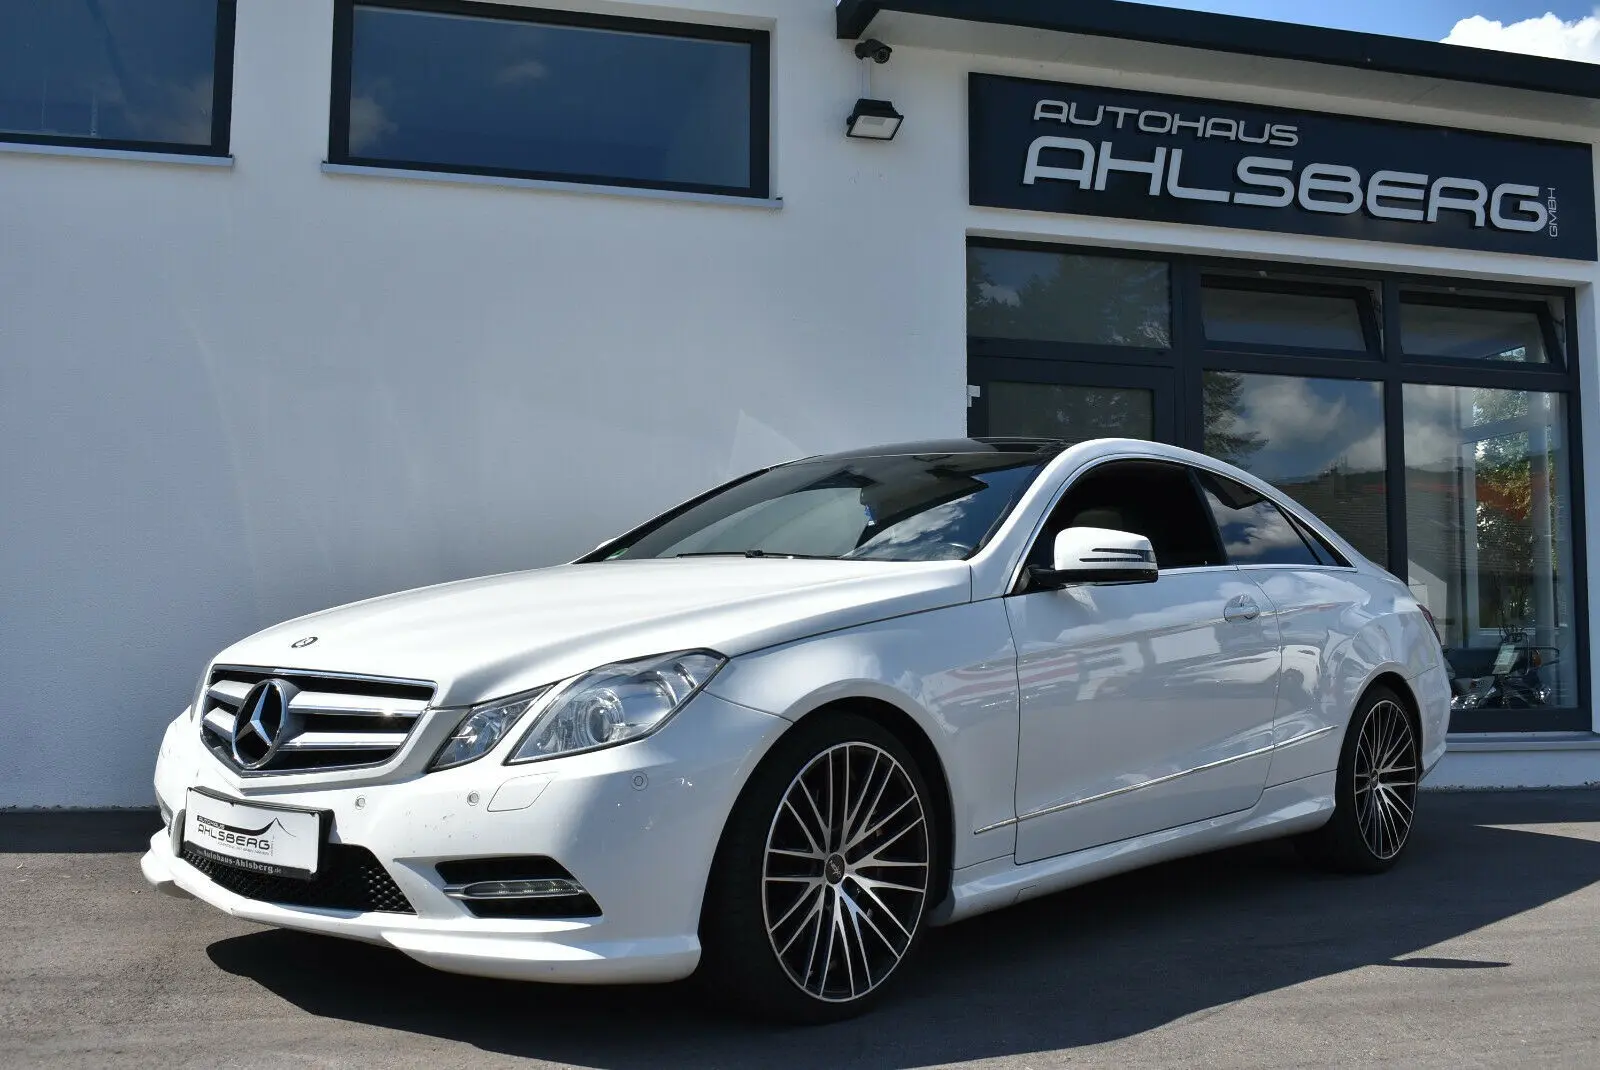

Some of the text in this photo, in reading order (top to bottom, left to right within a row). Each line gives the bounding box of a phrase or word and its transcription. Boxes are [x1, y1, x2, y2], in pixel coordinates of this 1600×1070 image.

[1033, 99, 1299, 147] AUTOHAUS
[1023, 136, 1549, 233] AHLSBERG
[1547, 187, 1559, 238] GMBH
[198, 823, 271, 850] AHLSBERG
